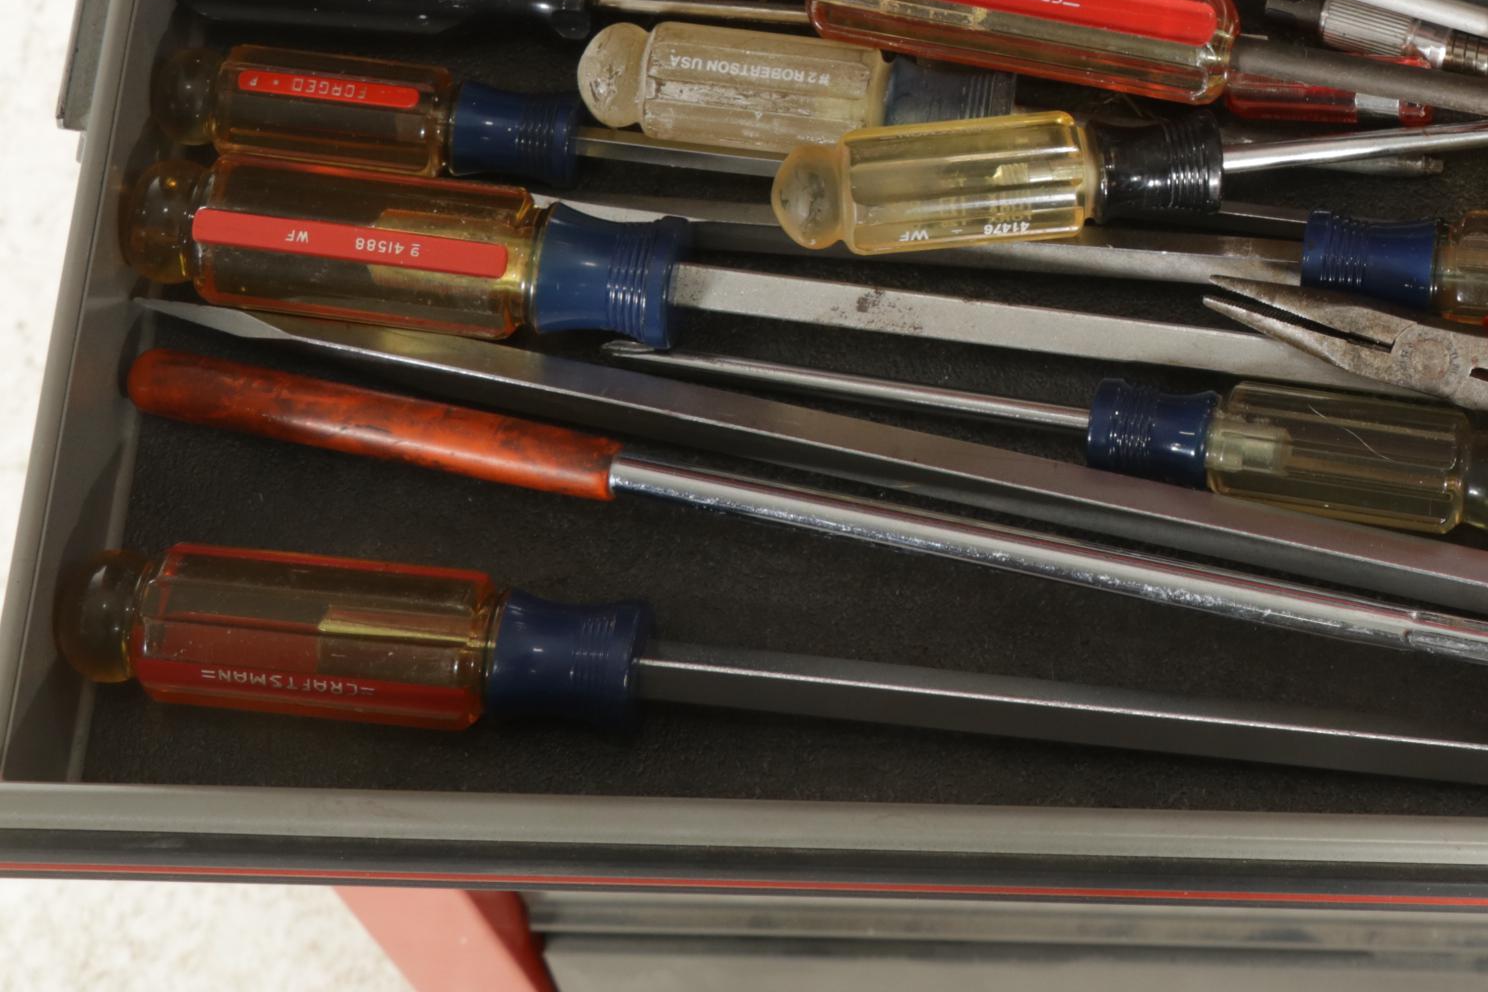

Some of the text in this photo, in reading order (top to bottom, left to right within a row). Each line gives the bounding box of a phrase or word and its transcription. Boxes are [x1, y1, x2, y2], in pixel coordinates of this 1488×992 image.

[669, 54, 701, 70] USA
[706, 59, 806, 83] ROBERTSON
[291, 77, 368, 100] FORGED
[284, 229, 310, 244] WF
[899, 221, 1031, 242] 41476 WF
[354, 237, 405, 256] 41588
